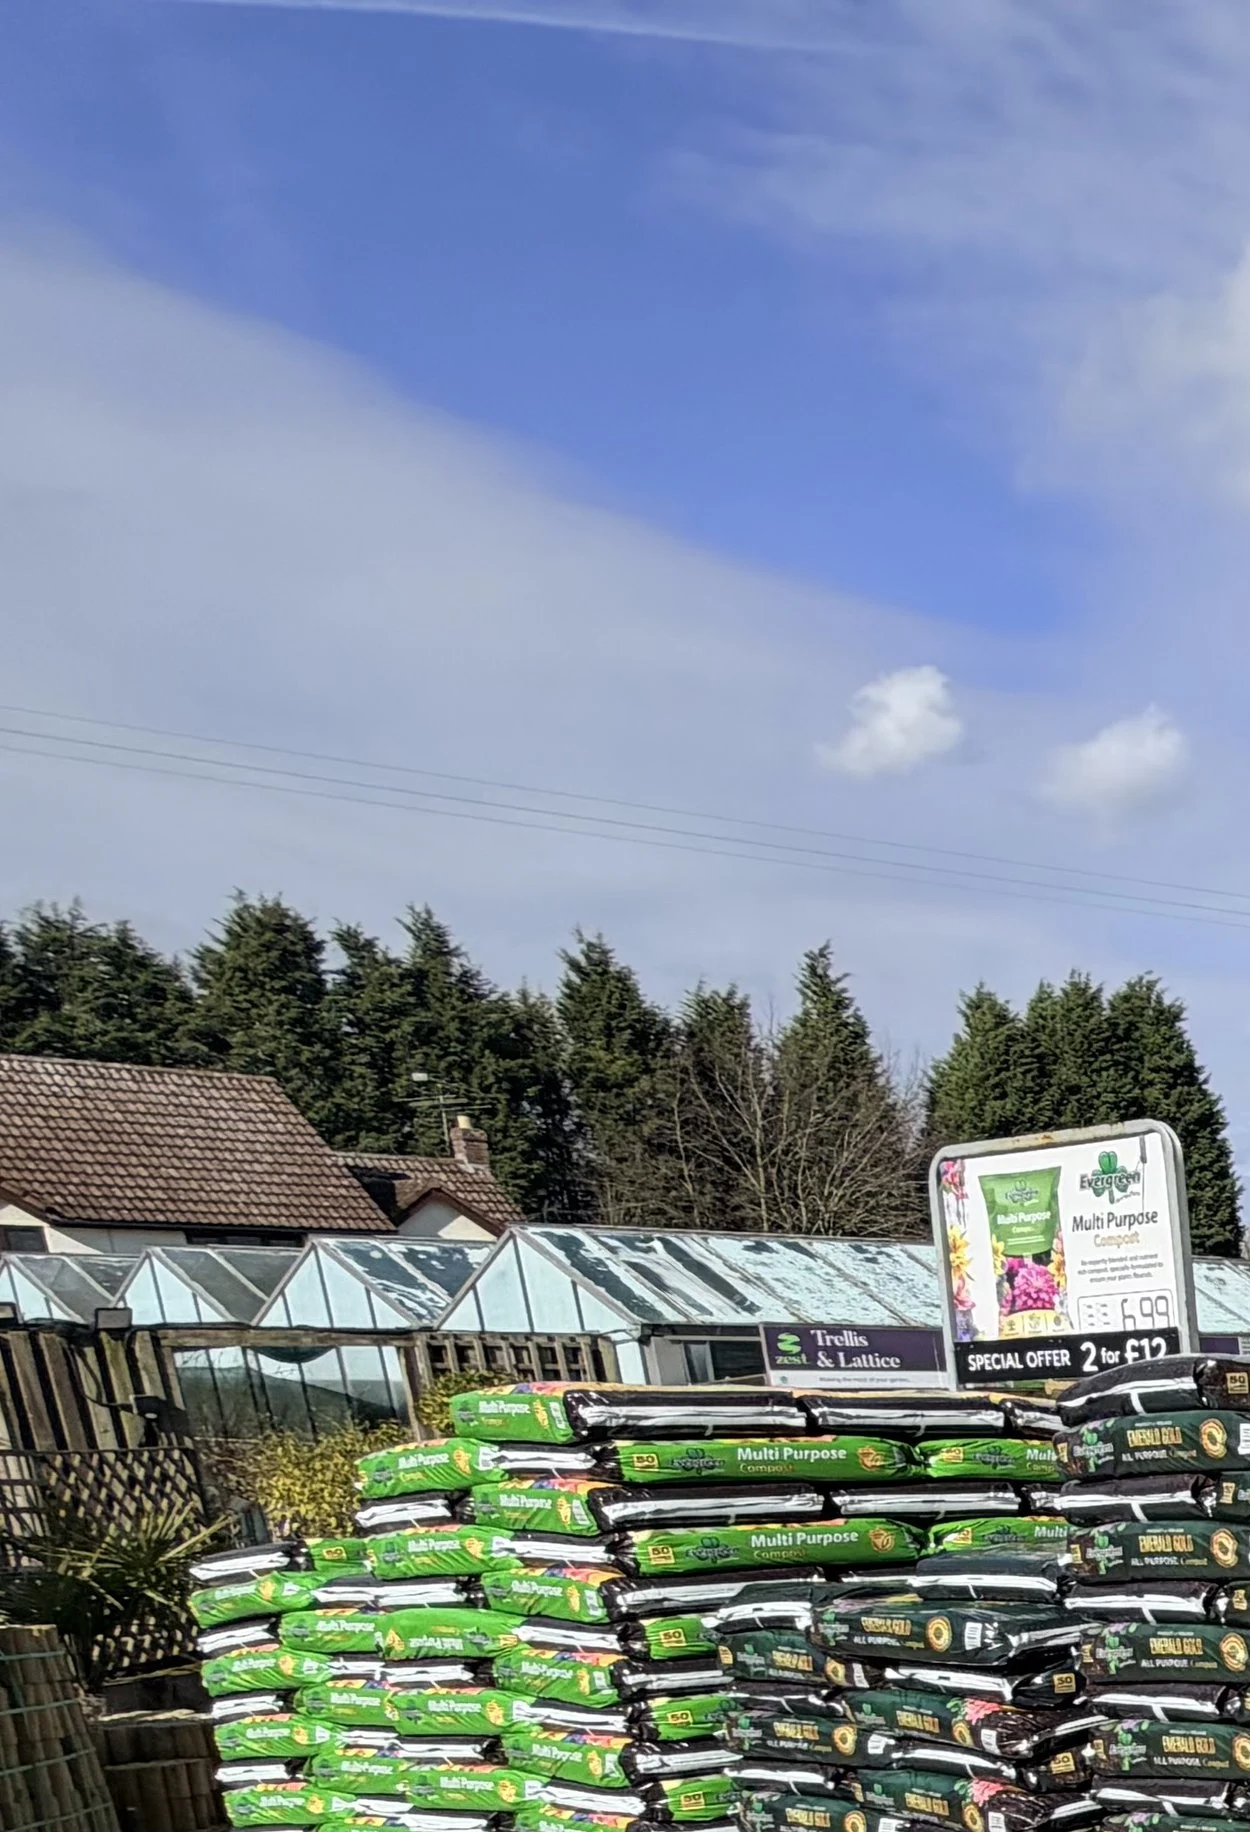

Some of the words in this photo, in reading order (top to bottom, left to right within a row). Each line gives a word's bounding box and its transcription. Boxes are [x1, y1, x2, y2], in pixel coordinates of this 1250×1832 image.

[1079, 1171, 1140, 1189] Evergreen
[1072, 1213, 1104, 1232] Multi
[1107, 1211, 1158, 1231] Purpose
[810, 1330, 869, 1347] Trellis
[817, 1351, 835, 1368] &
[840, 1352, 901, 1368] Lattice
[968, 1352, 1023, 1372] SPECIAL
[1026, 1350, 1072, 1368] OFFER
[1080, 1342, 1099, 1372] 2
[1101, 1343, 1120, 1364] for
[737, 1448, 779, 1461] Multi
[784, 1447, 847, 1461] Purpose
[751, 1534, 793, 1548] Multi
[796, 1531, 859, 1544] Purpose
